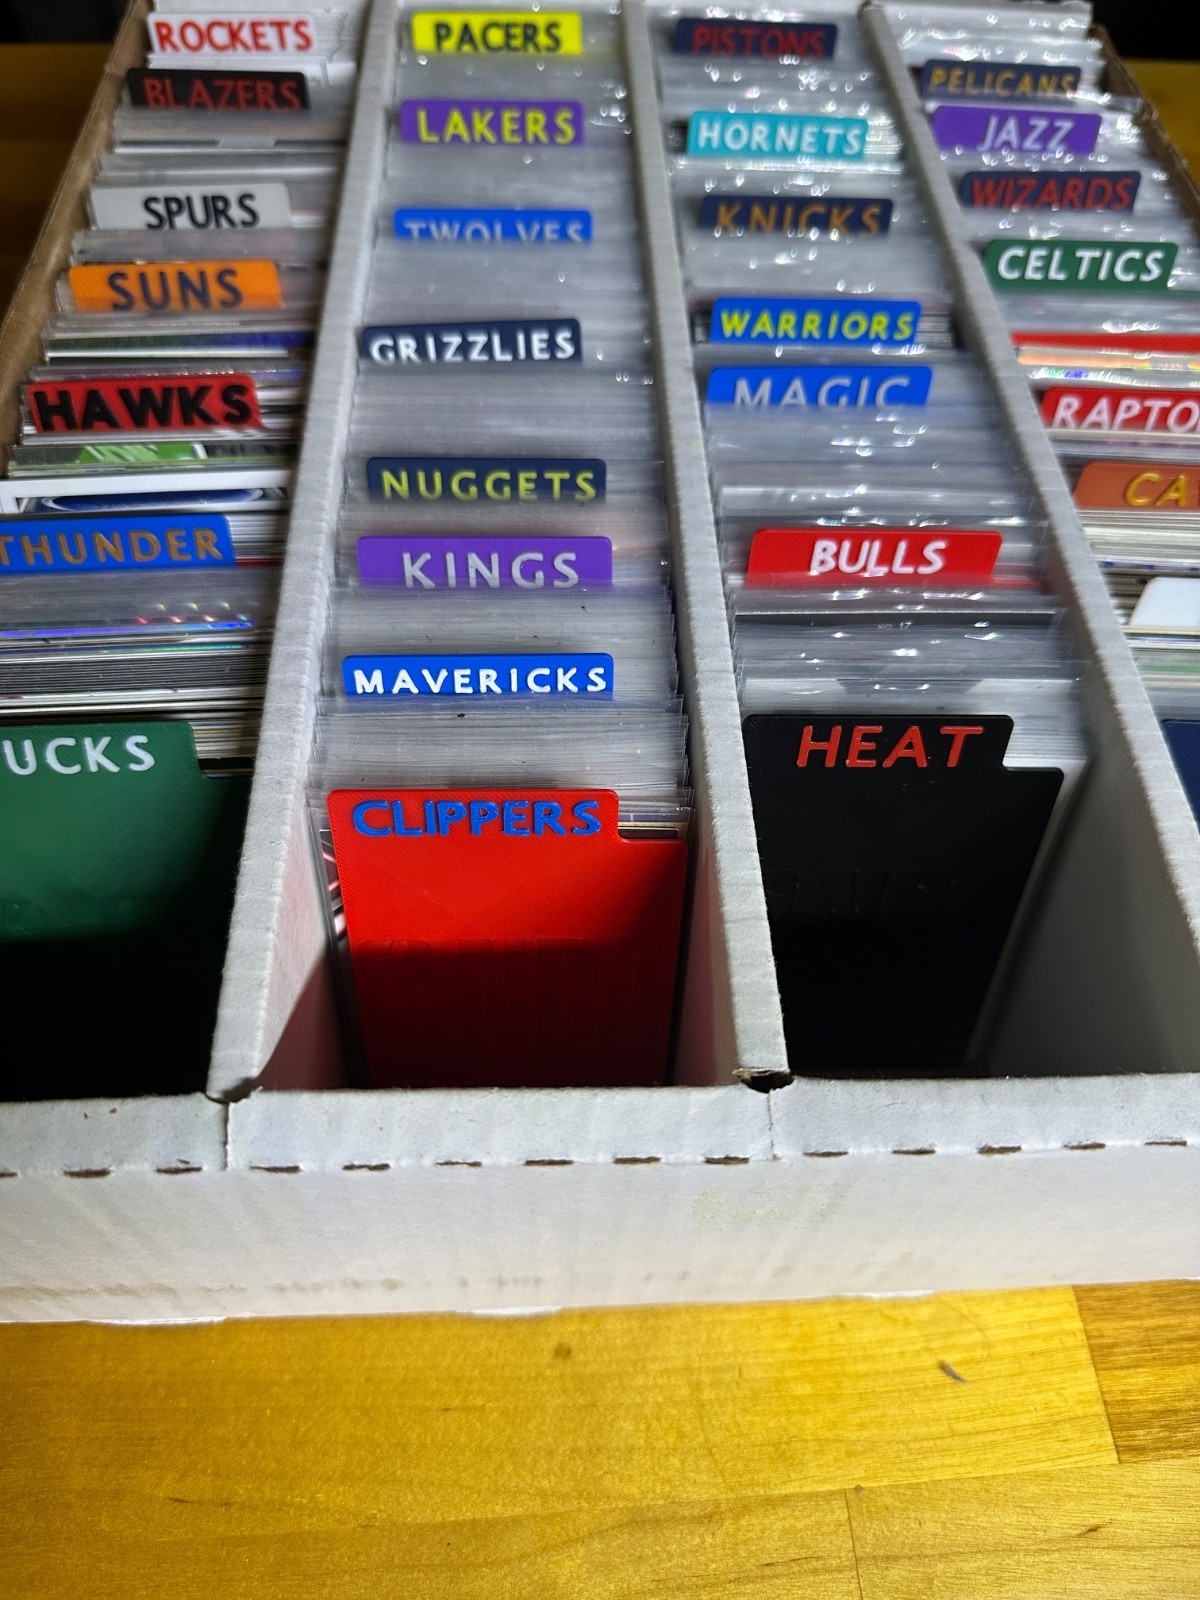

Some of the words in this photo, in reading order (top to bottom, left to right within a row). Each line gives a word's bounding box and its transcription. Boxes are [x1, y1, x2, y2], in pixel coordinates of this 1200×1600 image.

[154, 20, 313, 51] ROCKETS
[434, 21, 563, 52] PACERS
[691, 26, 827, 58] PISTONS
[143, 77, 300, 110] BLAZERS
[929, 67, 1076, 96] PELICANS
[417, 107, 576, 145] LAKERS
[697, 120, 865, 155] HORNETS
[976, 115, 1075, 152] JAZZ
[971, 176, 1135, 210] WIZARDS
[143, 193, 260, 230] SPURS
[714, 202, 882, 235] KNICKS
[997, 247, 1165, 282] CELTICS
[108, 269, 243, 311] SUNS
[720, 309, 915, 341] WARRIORS
[369, 328, 577, 364] GRIZZLIES
[33, 384, 253, 432] HAWKS
[733, 378, 909, 411] MAGIC
[1050, 396, 1200, 434] RAPTO
[380, 469, 596, 501] NUGGETS
[1124, 471, 1200, 508] CA
[0, 528, 223, 566] THUNDER
[809, 539, 947, 575] BULLS
[402, 552, 579, 589] KINGS
[353, 667, 606, 694] MAVERICKS
[796, 725, 984, 768] HEAT
[352, 800, 601, 837] CLIPPERS
